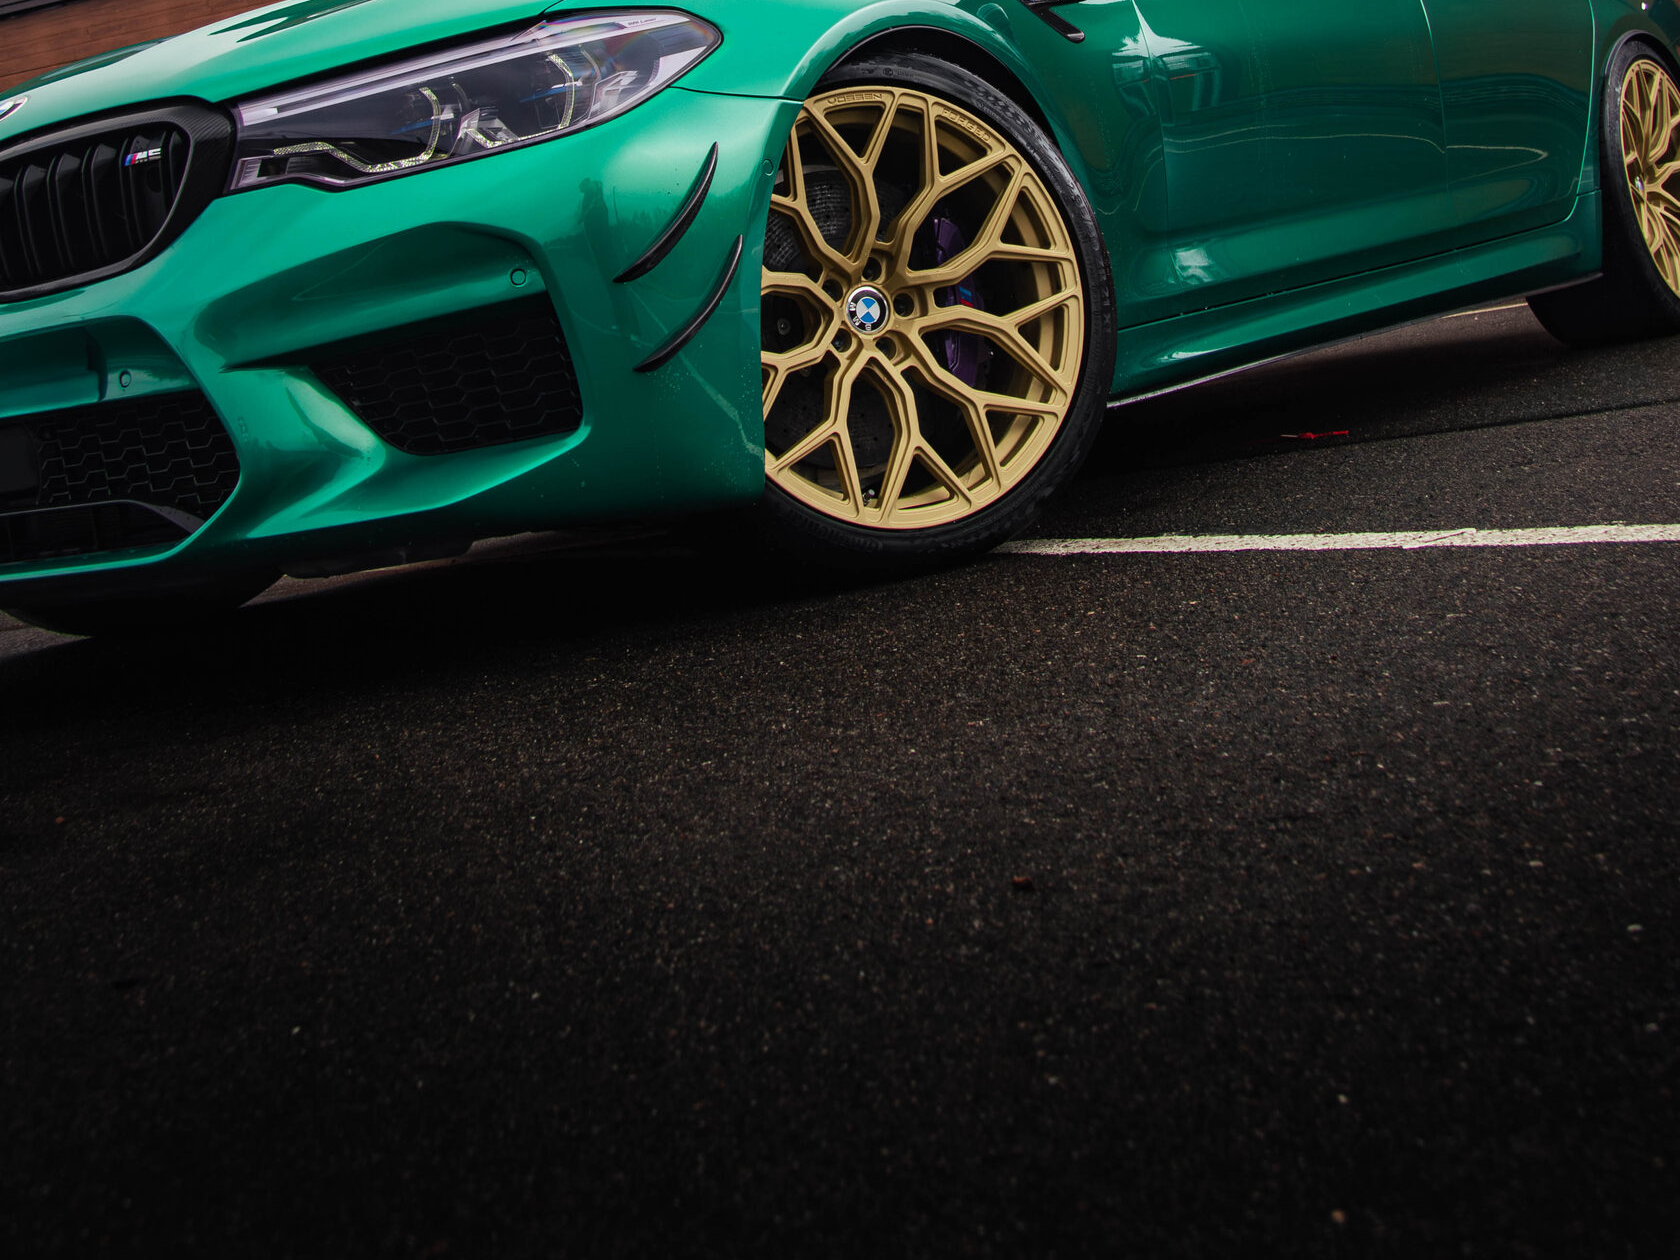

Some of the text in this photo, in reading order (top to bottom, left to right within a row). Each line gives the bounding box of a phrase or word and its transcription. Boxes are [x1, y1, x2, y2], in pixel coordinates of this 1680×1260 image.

[827, 93, 883, 105] VOSSEN
[942, 107, 991, 143] FORGED
[848, 301, 872, 331] BMW
